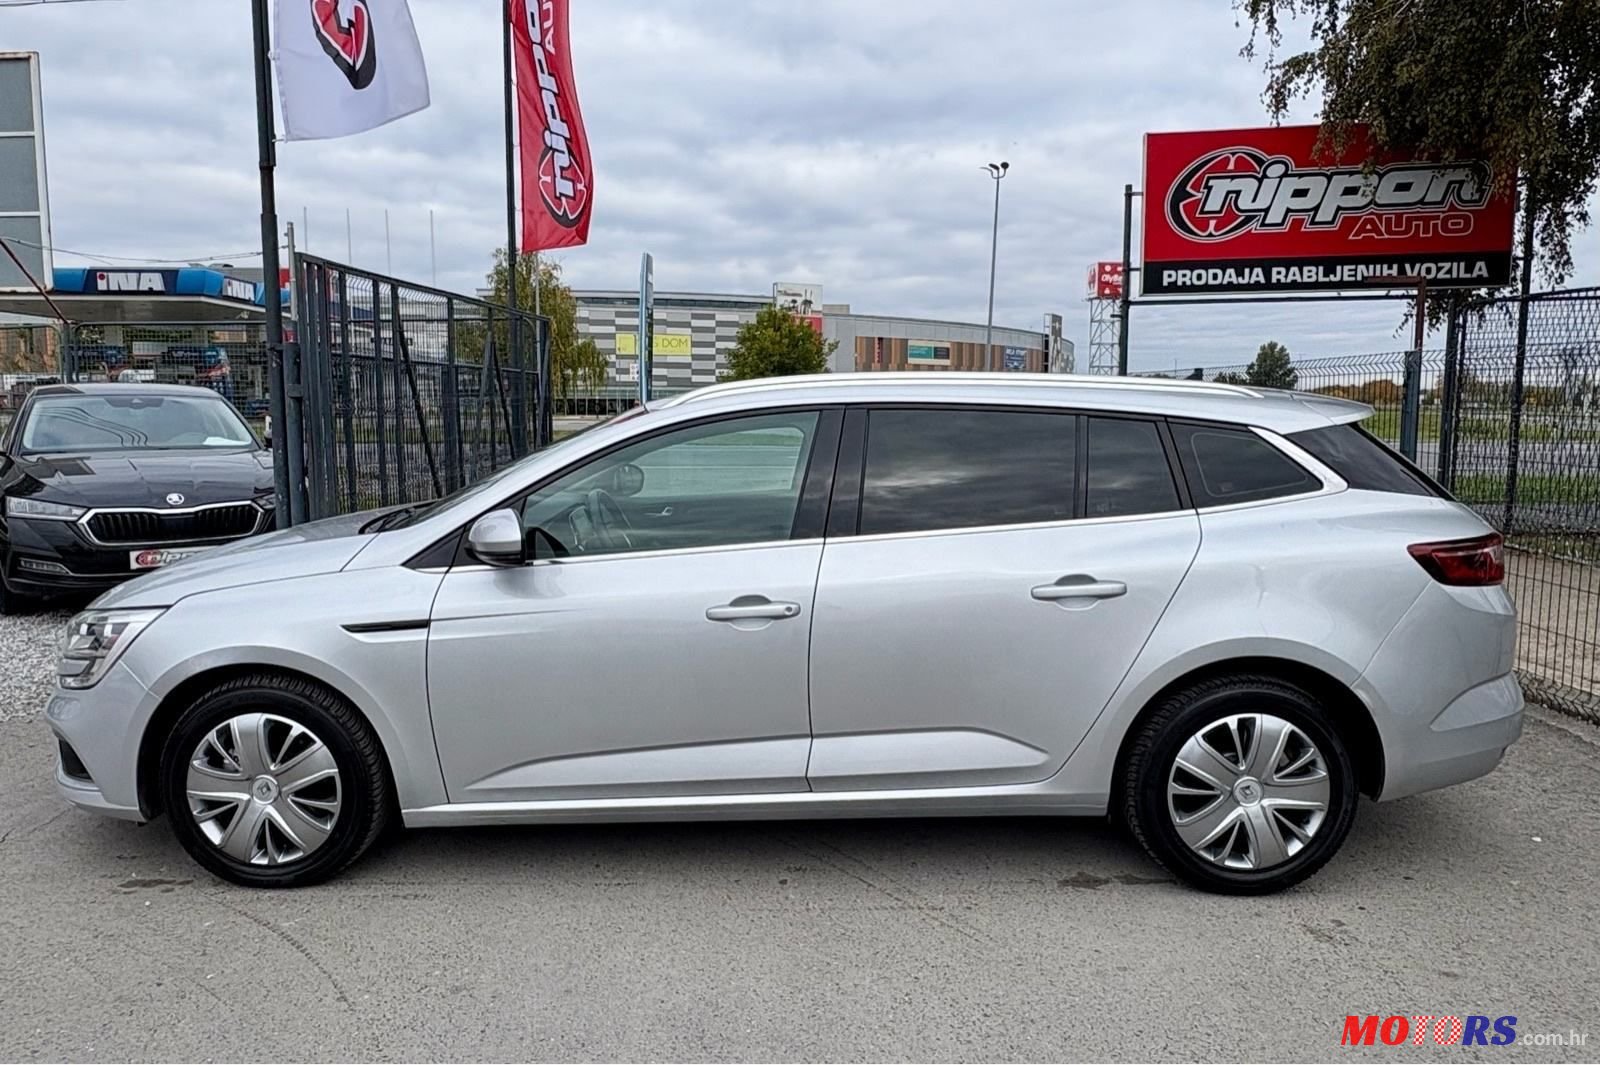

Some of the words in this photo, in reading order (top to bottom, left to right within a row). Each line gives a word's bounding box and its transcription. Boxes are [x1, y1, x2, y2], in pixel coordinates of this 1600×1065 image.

[543, 0, 555, 55] AU
[525, 0, 575, 198] nippo
[1202, 161, 1484, 226] nippon
[1349, 211, 1473, 239] AUTO
[1162, 267, 1266, 287] PRODAJA
[1271, 263, 1398, 284] RABLJENIH
[1404, 261, 1489, 280] VOZILA
[661, 338, 688, 348] DOM
